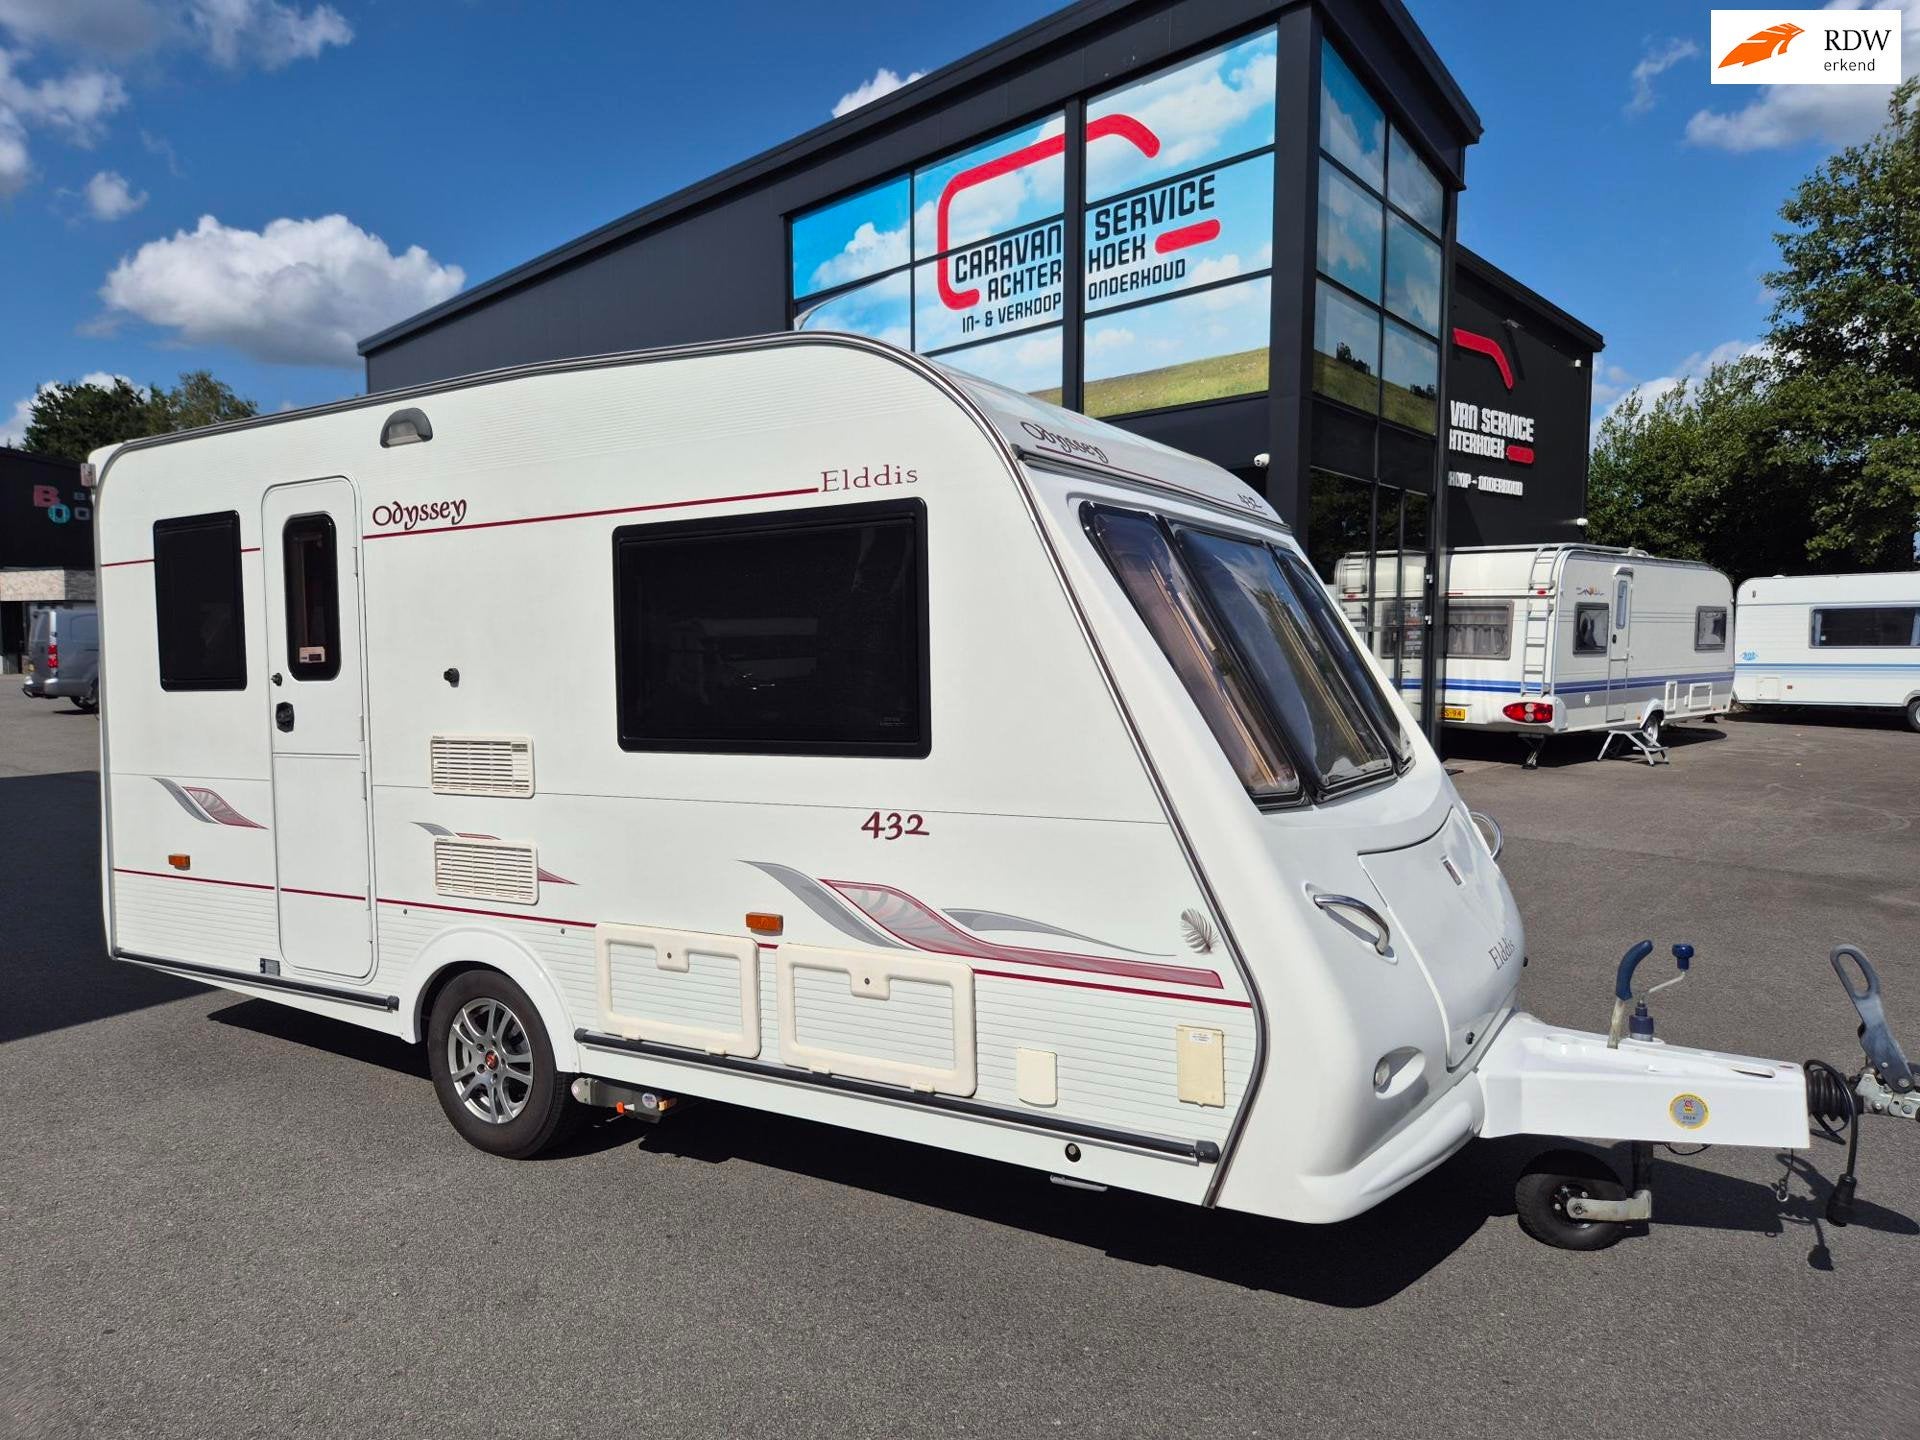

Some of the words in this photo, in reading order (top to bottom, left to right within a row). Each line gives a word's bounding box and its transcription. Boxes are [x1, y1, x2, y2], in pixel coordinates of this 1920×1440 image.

[954, 224, 1062, 284] CARAVAN
[1094, 174, 1216, 242] SERVICE
[985, 311, 994, 327] &
[998, 292, 1062, 325] VERKOOP
[1088, 258, 1186, 301] ONDERHOUD
[1020, 421, 1109, 464] Odyssey
[1450, 400, 1478, 431] VAN
[1481, 408, 1535, 443] SERVICE
[820, 464, 918, 492] Elddis
[372, 498, 467, 530] Odyssey
[861, 811, 930, 840] 432
